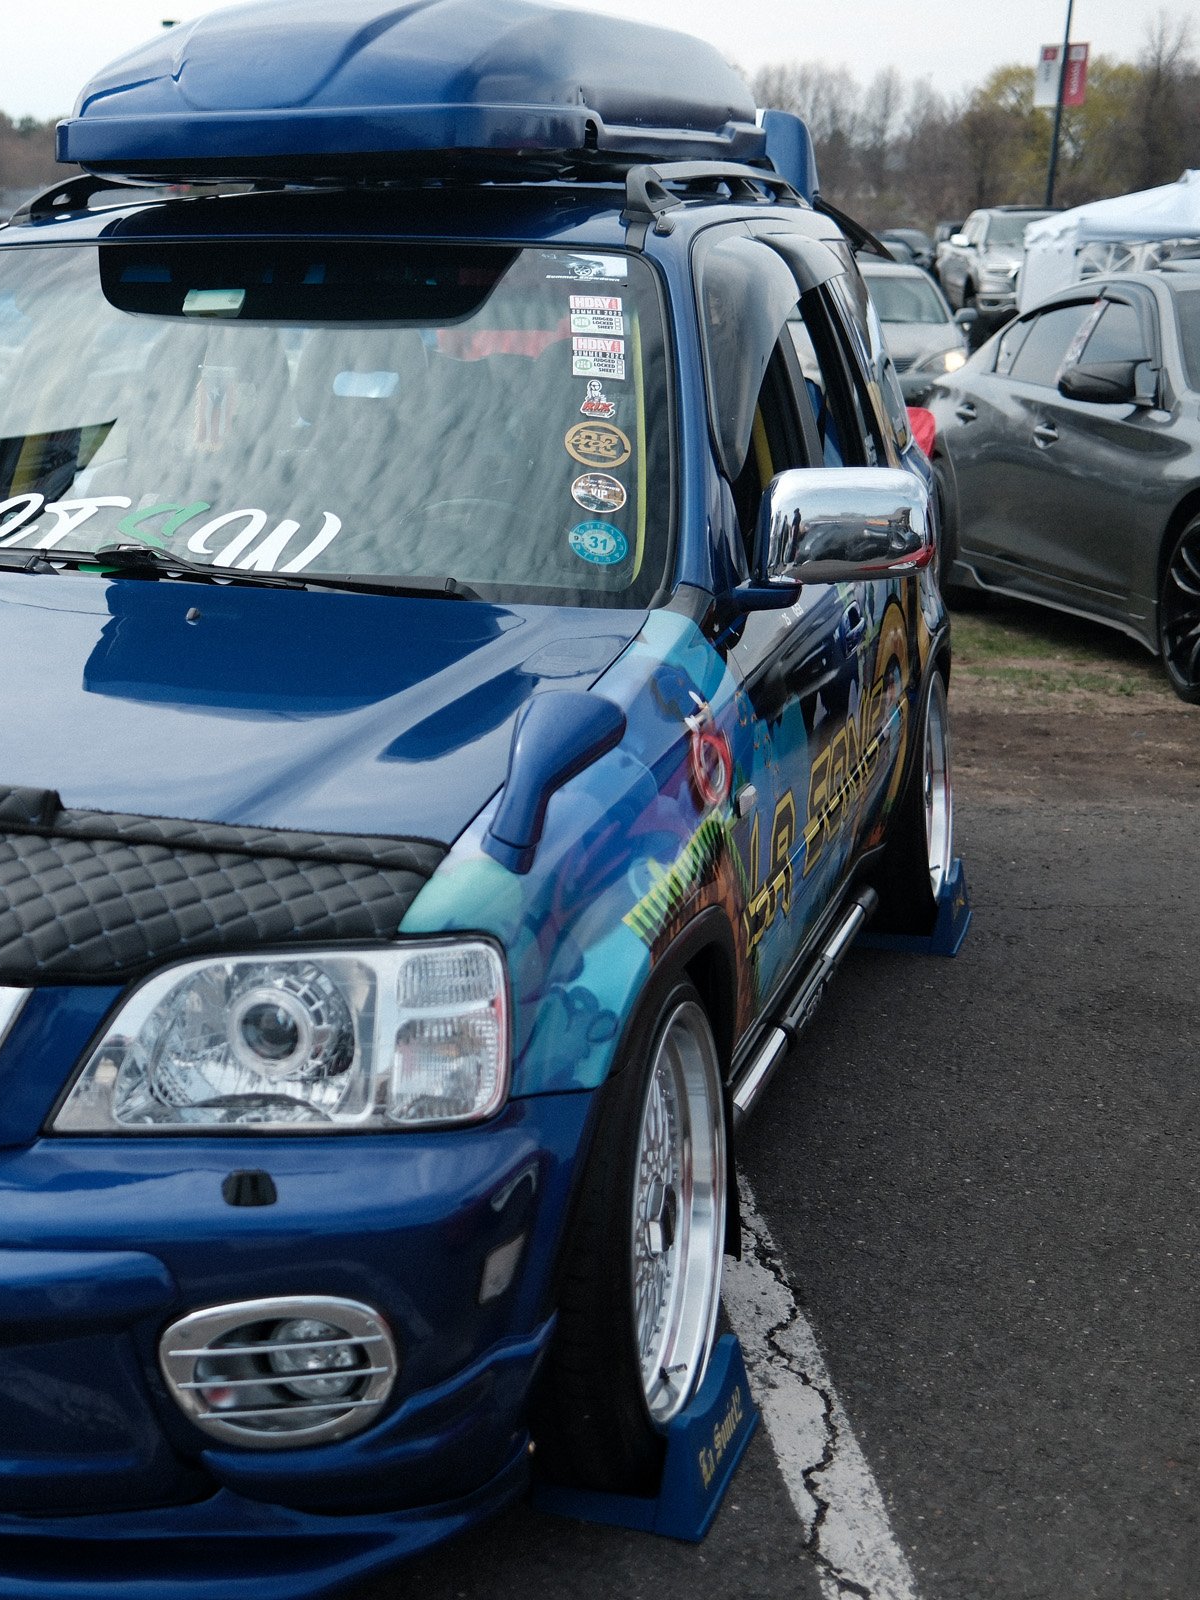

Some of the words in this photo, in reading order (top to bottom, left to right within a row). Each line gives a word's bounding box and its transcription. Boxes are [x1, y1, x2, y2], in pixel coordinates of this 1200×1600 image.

[574, 350, 603, 358] SUMMER
[590, 488, 608, 499] VIP
[588, 535, 608, 551] 31
